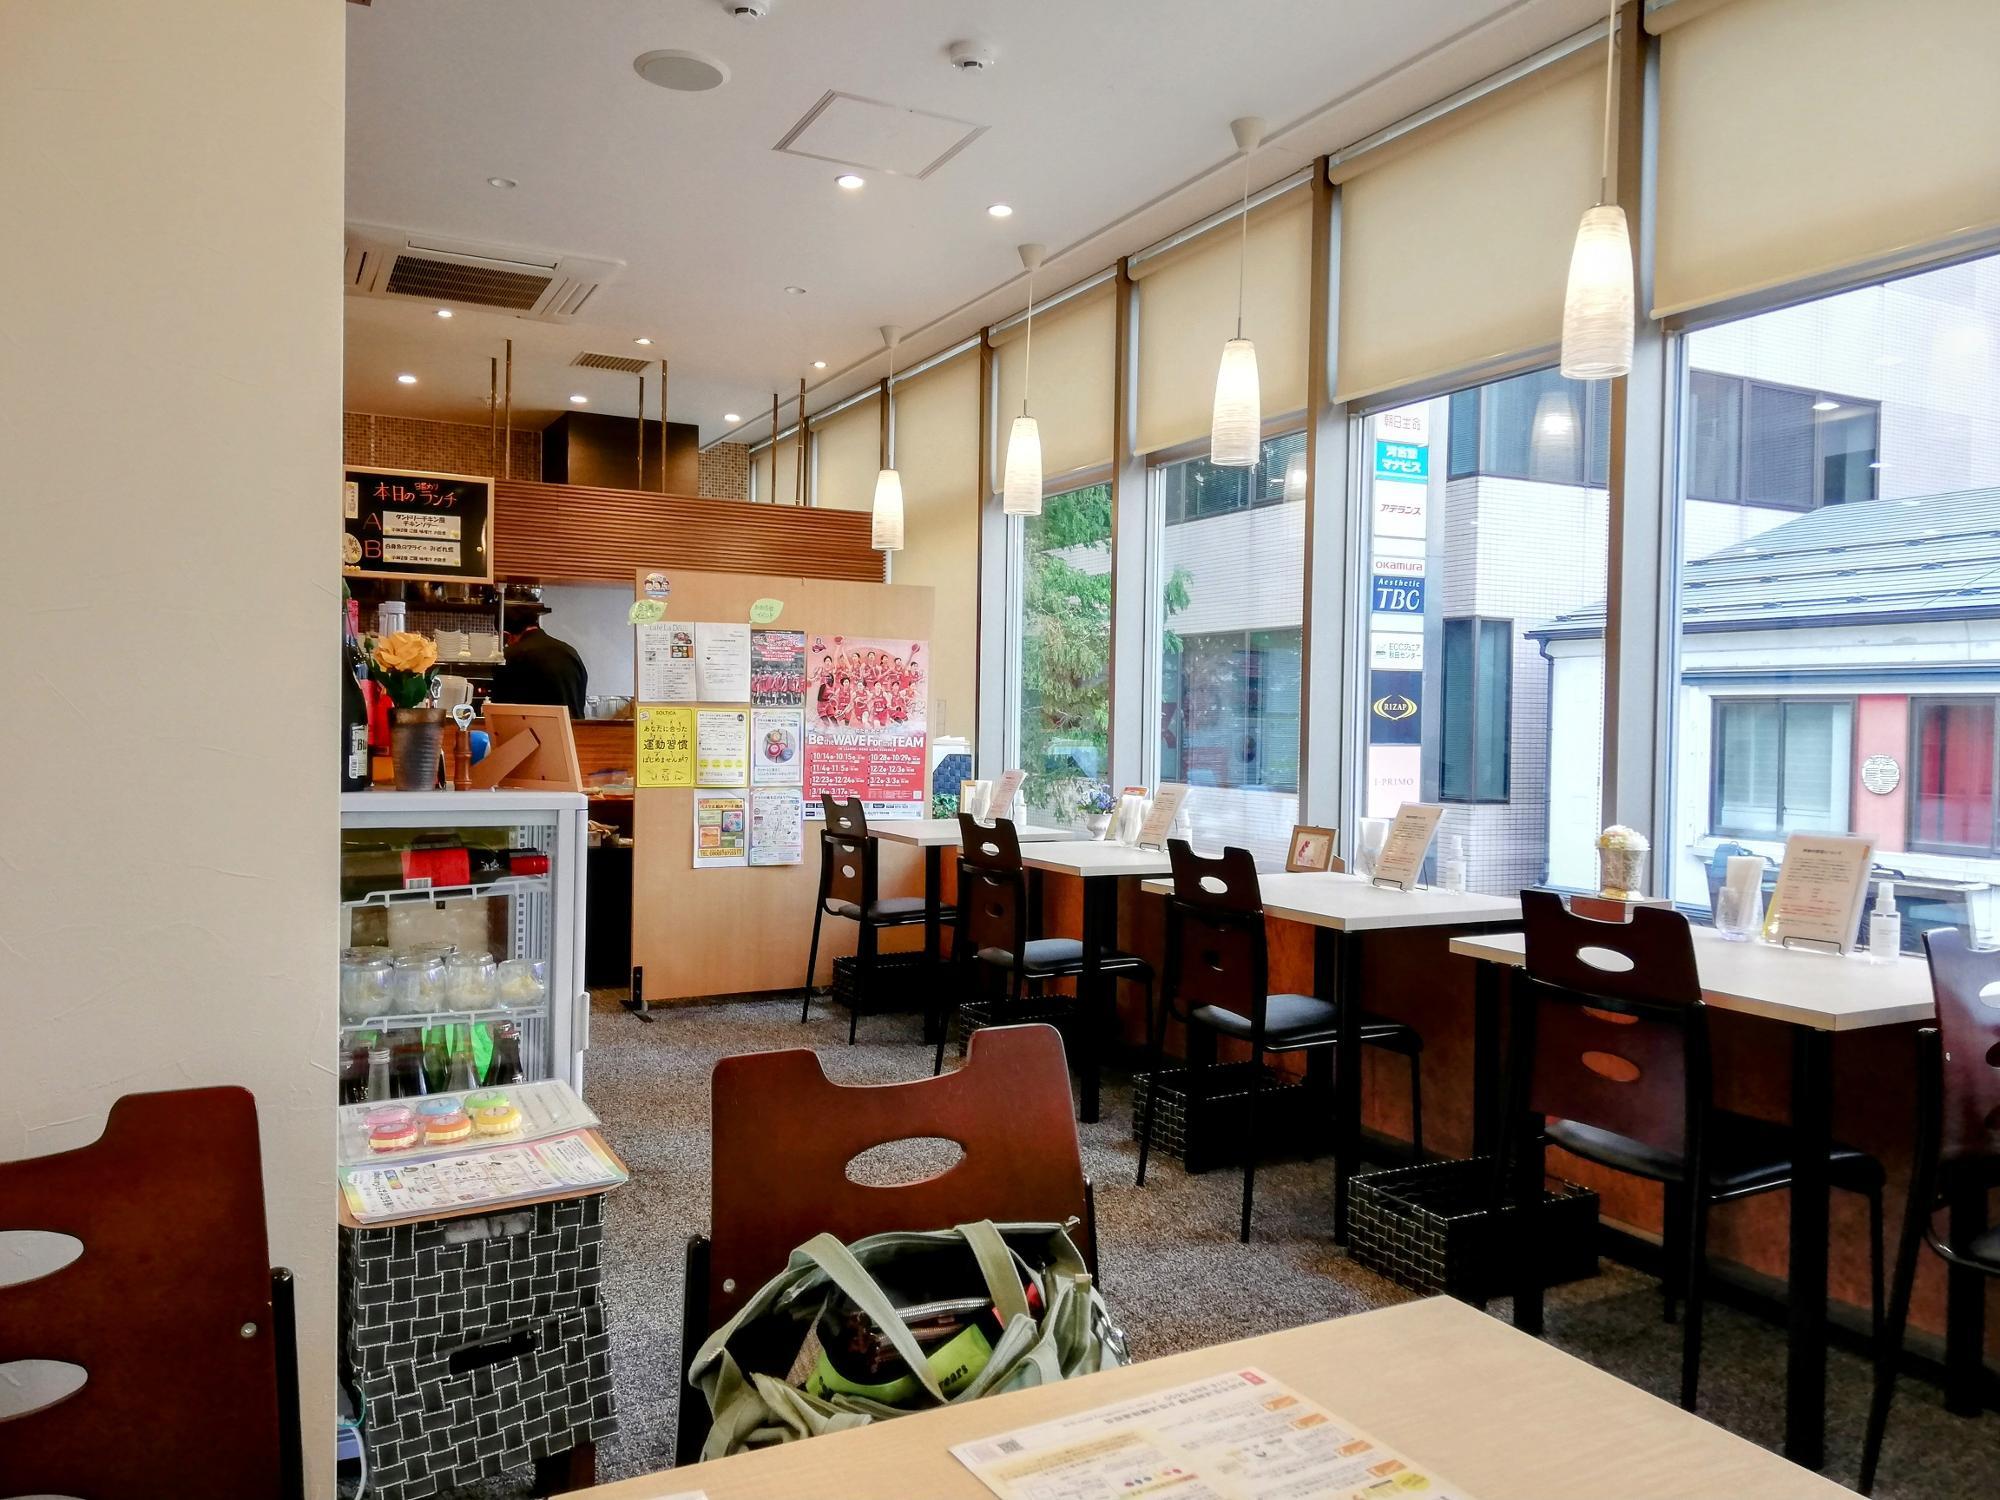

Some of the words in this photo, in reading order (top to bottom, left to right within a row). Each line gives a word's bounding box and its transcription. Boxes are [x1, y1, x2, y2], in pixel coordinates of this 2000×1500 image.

[373, 482, 415, 501] 本日の
[420, 490, 457, 508] ランチ
[1380, 504, 1422, 515] アデランス
[363, 512, 382, 531] A
[364, 540, 382, 558] B
[1375, 561, 1423, 571] okamura
[1378, 577, 1420, 587] Aesthetic
[1377, 588, 1420, 610] TBC
[1384, 703, 1408, 711] RIZAP
[643, 739, 688, 750] 運動習慣
[808, 734, 824, 745] Be
[833, 735, 866, 746] WAVE
[892, 736, 924, 748] TEAM
